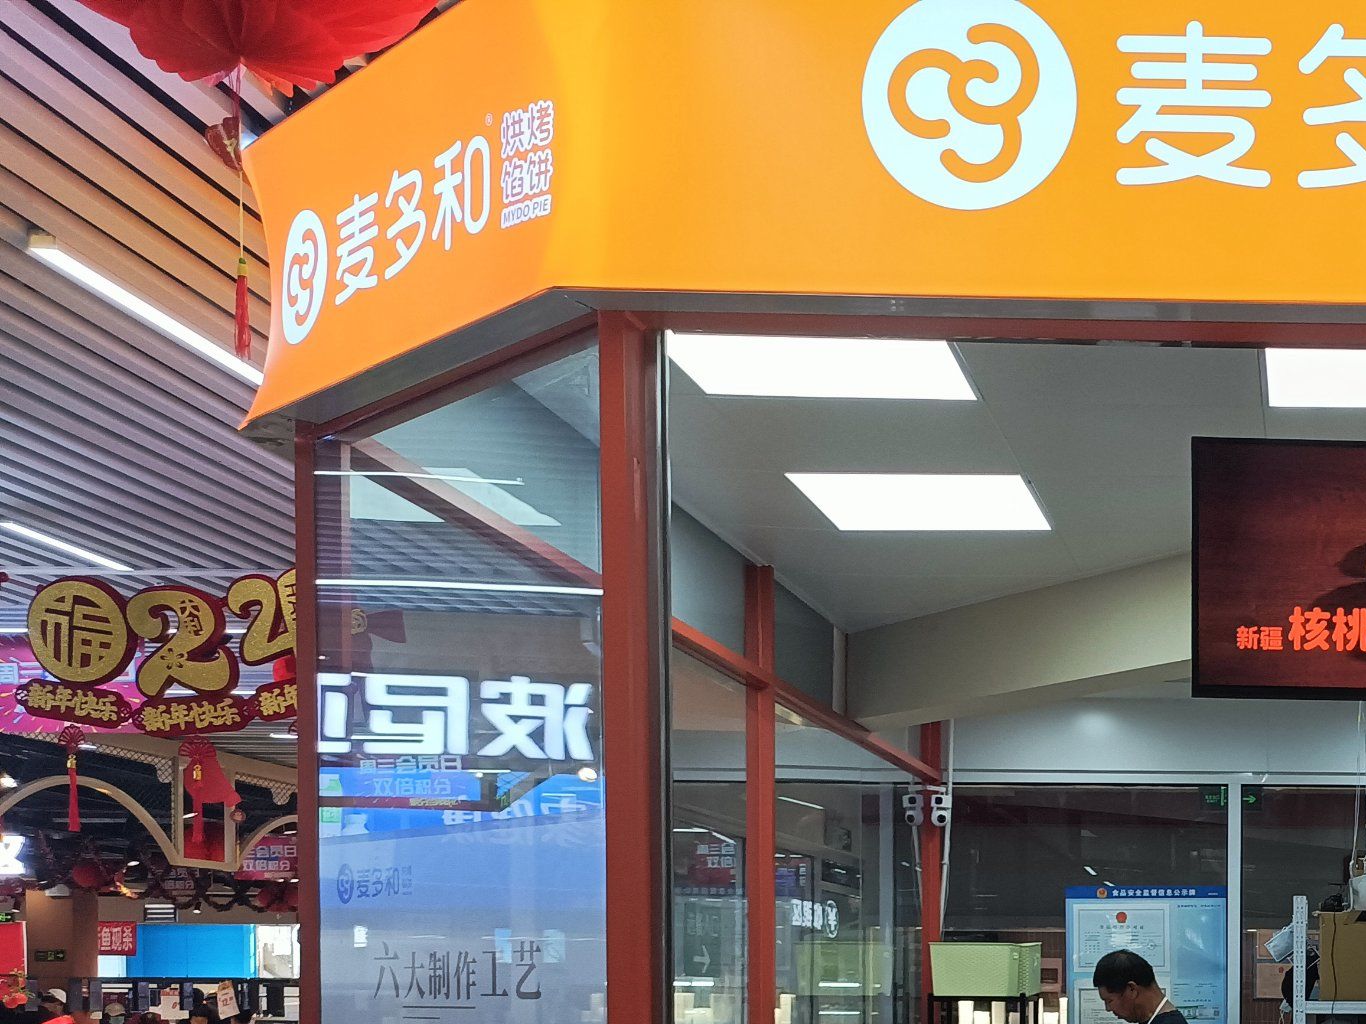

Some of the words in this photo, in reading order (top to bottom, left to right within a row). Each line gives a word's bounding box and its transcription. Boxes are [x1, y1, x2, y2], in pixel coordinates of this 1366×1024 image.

[501, 100, 555, 154] 烘烤
[501, 151, 554, 203] 馅饼
[334, 135, 492, 306] 麦多和
[502, 203, 530, 227] MYDO
[530, 197, 552, 217] PIE
[1236, 625, 1283, 651] 新疆
[27, 682, 118, 722] 新年快乐
[142, 697, 241, 732] 新年快乐
[372, 778, 452, 796] 双倍积分
[98, 925, 133, 951] 鱼现杀
[373, 940, 542, 1000] 六大制作工艺
